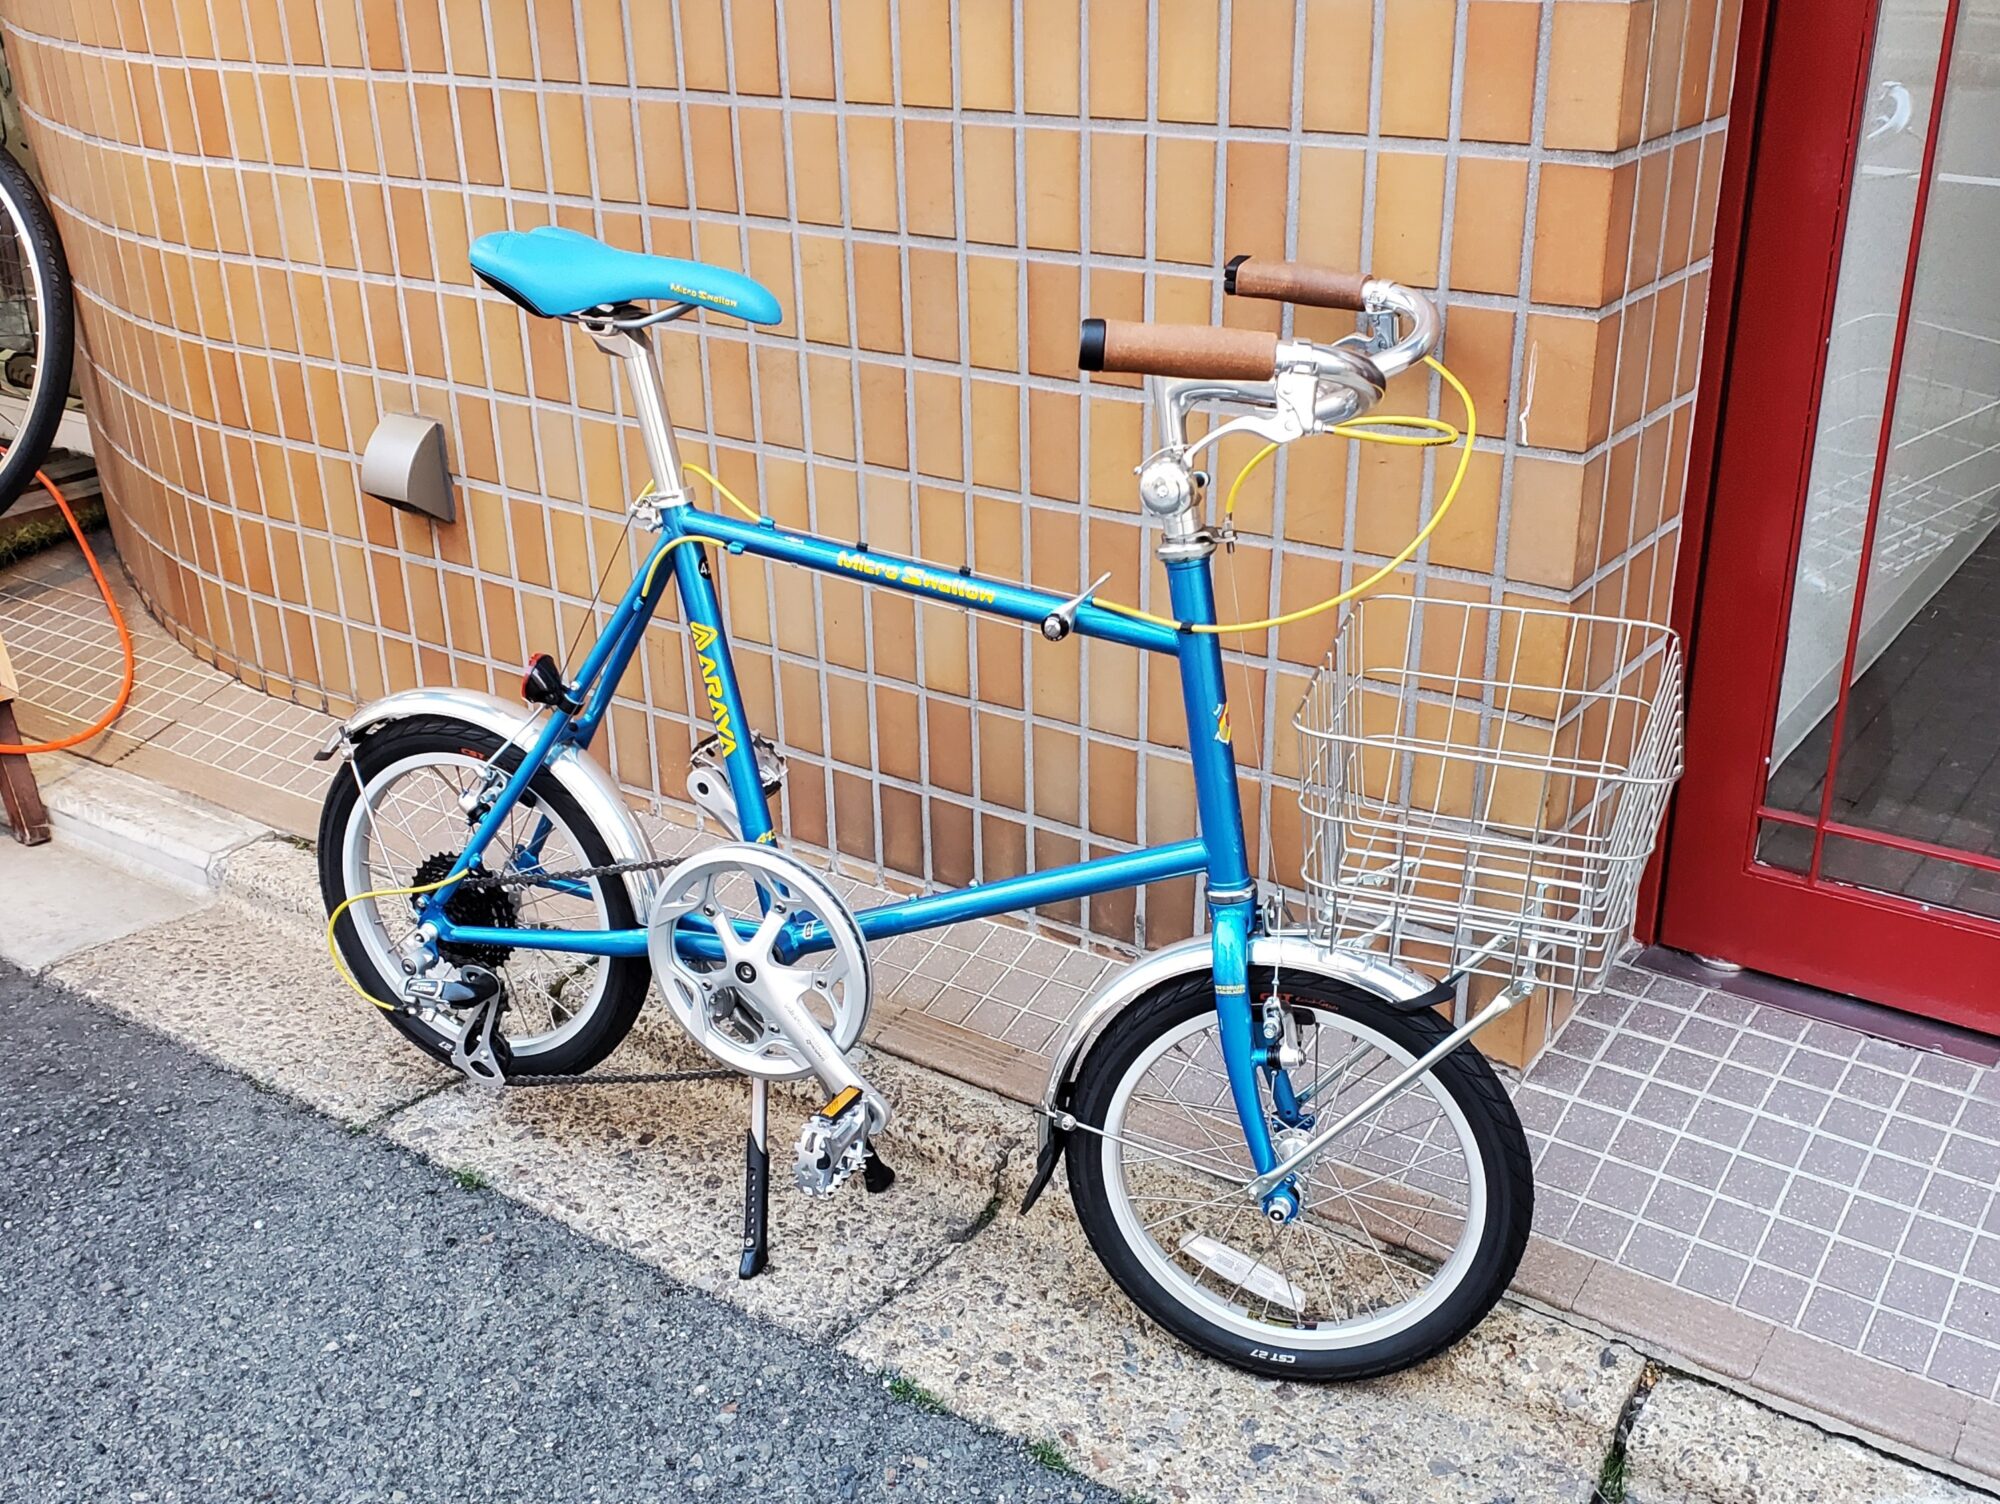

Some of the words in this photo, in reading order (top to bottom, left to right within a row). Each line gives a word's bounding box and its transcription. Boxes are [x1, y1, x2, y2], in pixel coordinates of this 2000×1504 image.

[671, 283, 697, 297] Micro
[837, 551, 898, 580] Micro
[902, 566, 995, 603] Swallow
[698, 654, 737, 757] ARAYA
[461, 748, 484, 759] CST
[1250, 1349, 1268, 1359] 27
[1270, 1353, 1296, 1364] CST
